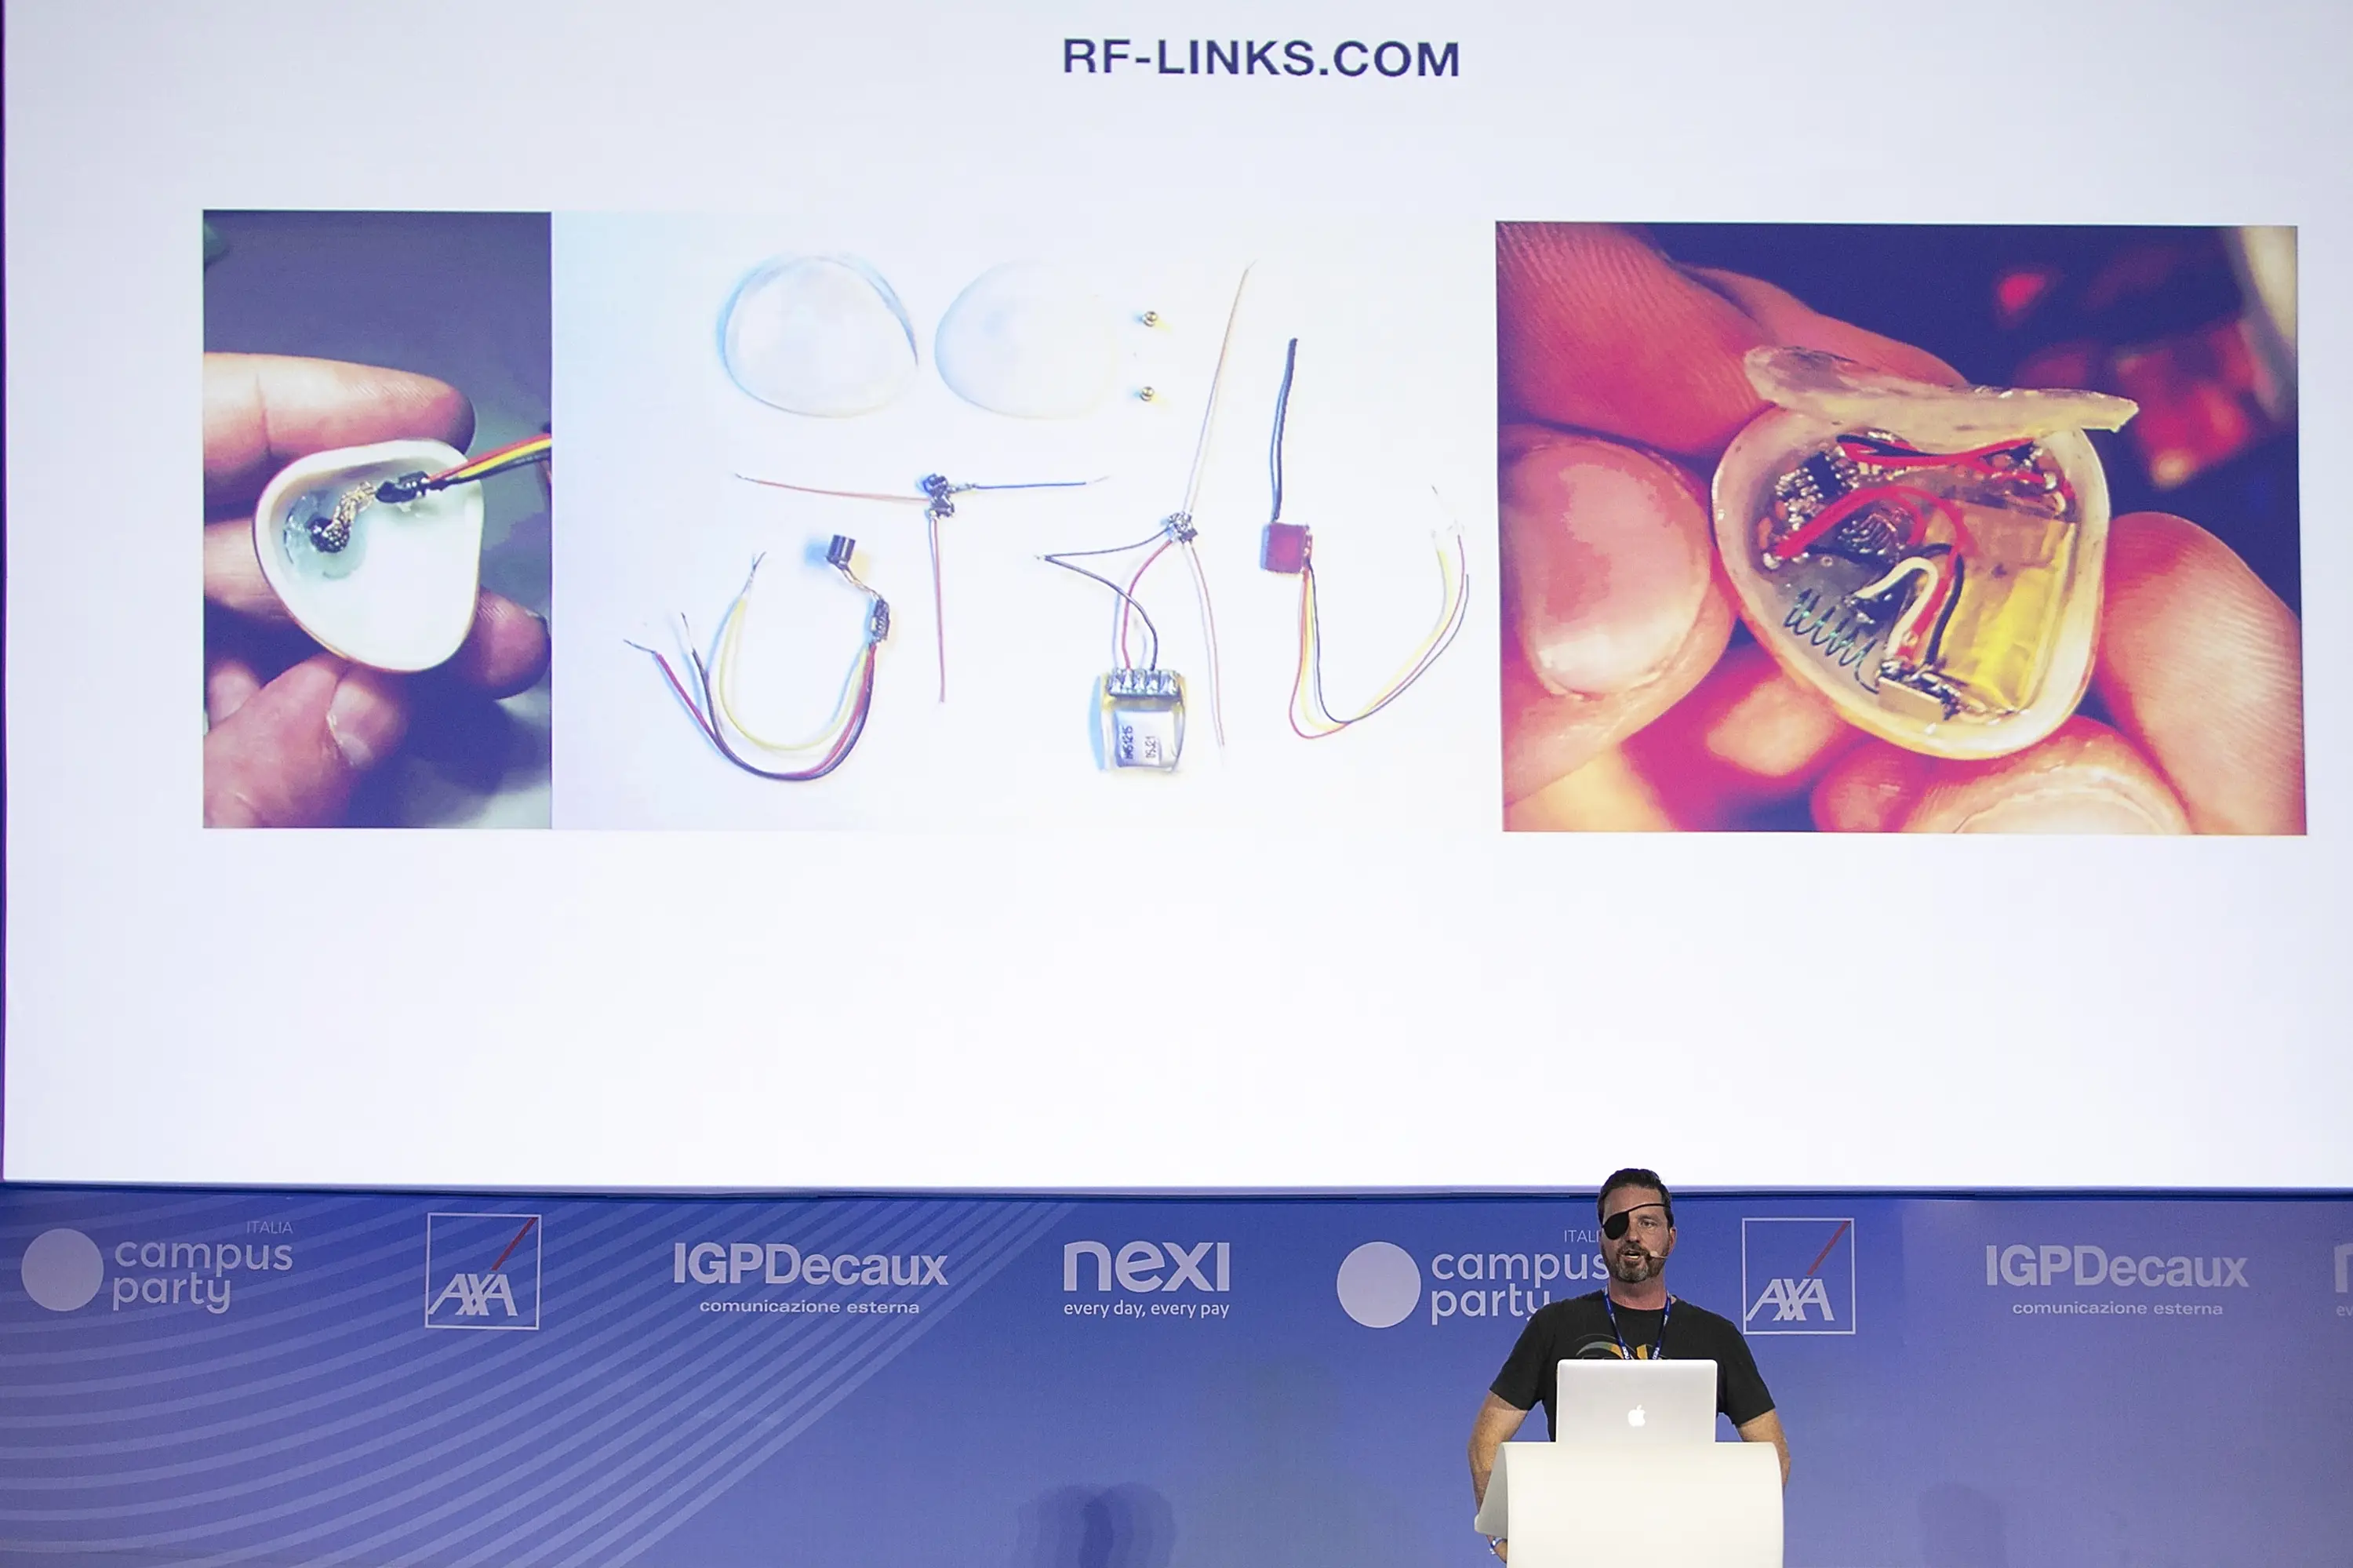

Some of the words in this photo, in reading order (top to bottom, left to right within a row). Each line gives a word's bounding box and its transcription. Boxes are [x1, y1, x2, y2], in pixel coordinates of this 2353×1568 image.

[1064, 38, 1460, 77] RF-LINKS.COM
[246, 1220, 293, 1235] ITALIA
[1564, 1229, 1601, 1243] ITALI
[115, 1241, 293, 1278] campus
[674, 1242, 949, 1286] IGPDecaux
[1064, 1240, 1230, 1293] nexi
[1431, 1253, 1610, 1289] campus
[1986, 1244, 2249, 1288] IGPDecaux
[113, 1271, 231, 1314] party
[427, 1274, 518, 1316] AXA
[700, 1299, 840, 1314] comunicazione
[846, 1301, 920, 1315] esterna
[1064, 1304, 1110, 1319] every
[1114, 1299, 1146, 1318] day,
[1151, 1304, 1196, 1319] every
[1201, 1304, 1230, 1319] pay
[1745, 1279, 1835, 1321] AXA
[2013, 1301, 2148, 1315] comunicazione
[2153, 1302, 2224, 1315] esterna
